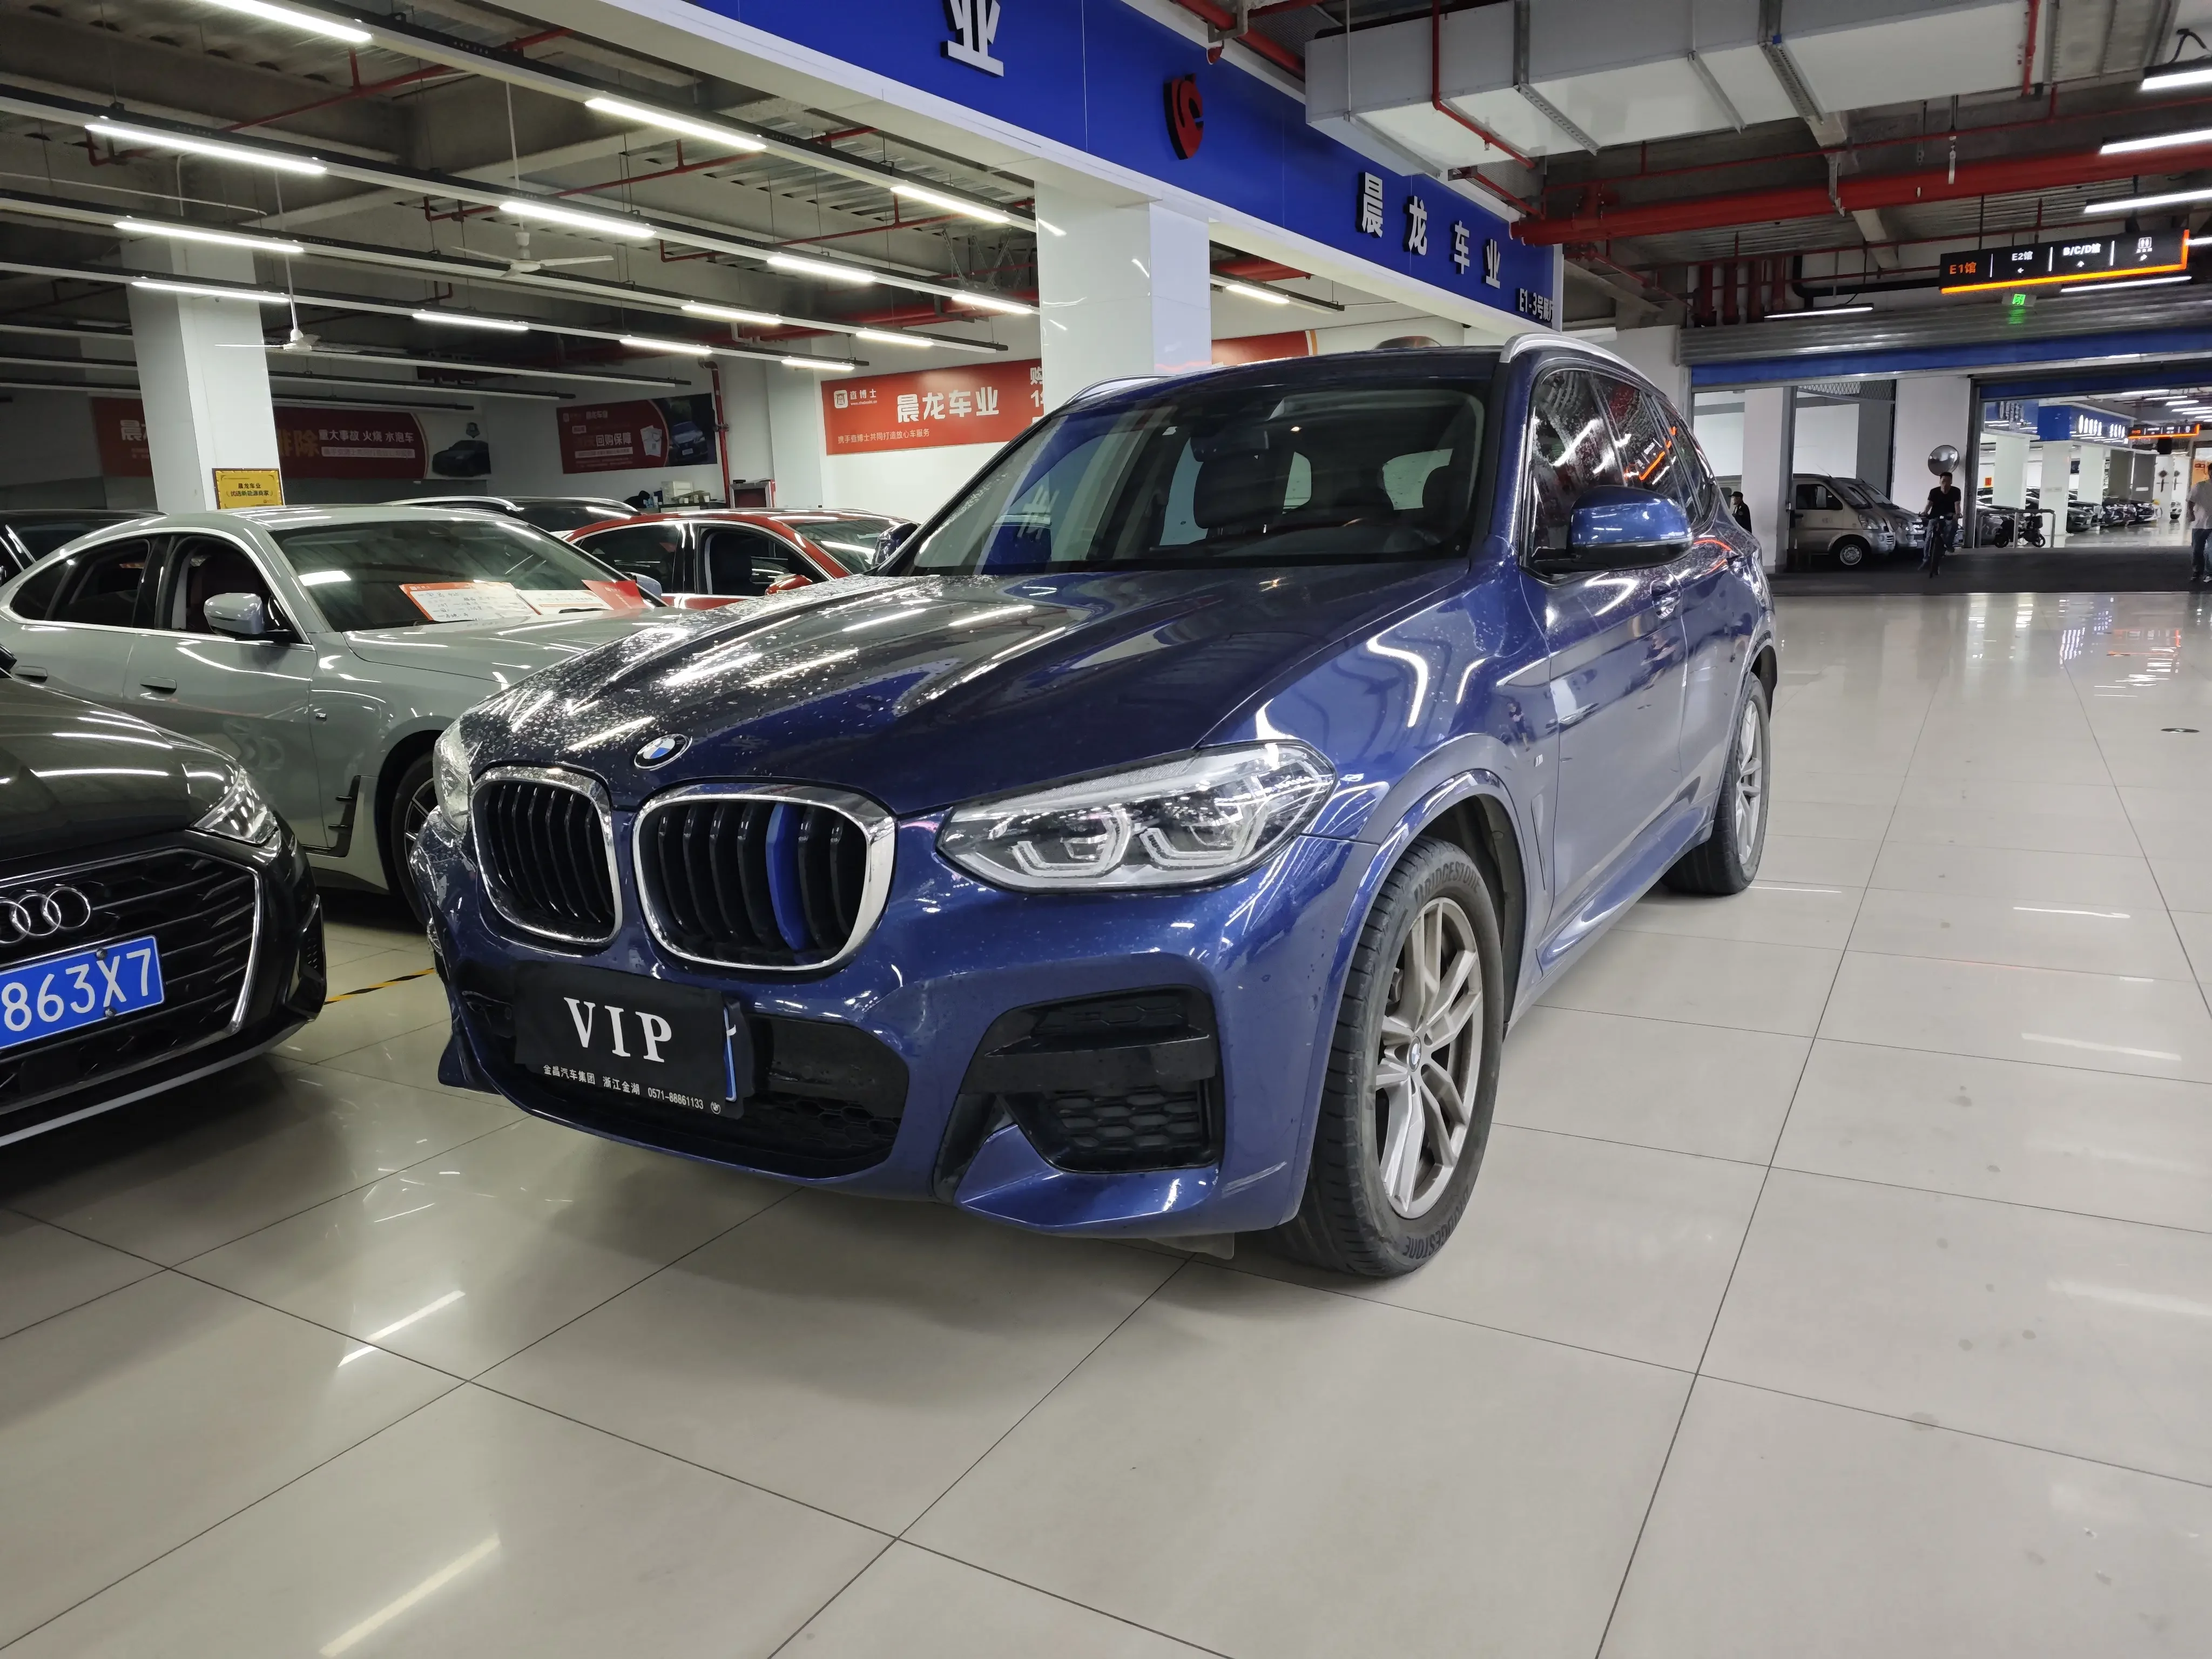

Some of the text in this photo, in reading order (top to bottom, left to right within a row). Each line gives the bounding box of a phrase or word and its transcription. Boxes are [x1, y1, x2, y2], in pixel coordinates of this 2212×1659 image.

[1361, 171, 1501, 289] 晨龙车业
[2011, 251, 2033, 261] E2馆
[2062, 243, 2101, 255] B/C/D馆
[1949, 262, 1977, 274] E1馆
[849, 389, 876, 400] 查博士
[1030, 390, 1043, 407] 1
[897, 386, 999, 423] 晨龙车业
[838, 428, 930, 444] 携手查博士共同打造放心车服务
[1, 948, 151, 1031] 863X7
[563, 996, 672, 1063] VIP
[543, 1064, 704, 1110] 金昌汽车集团 浙江金湖 0571-88861133
